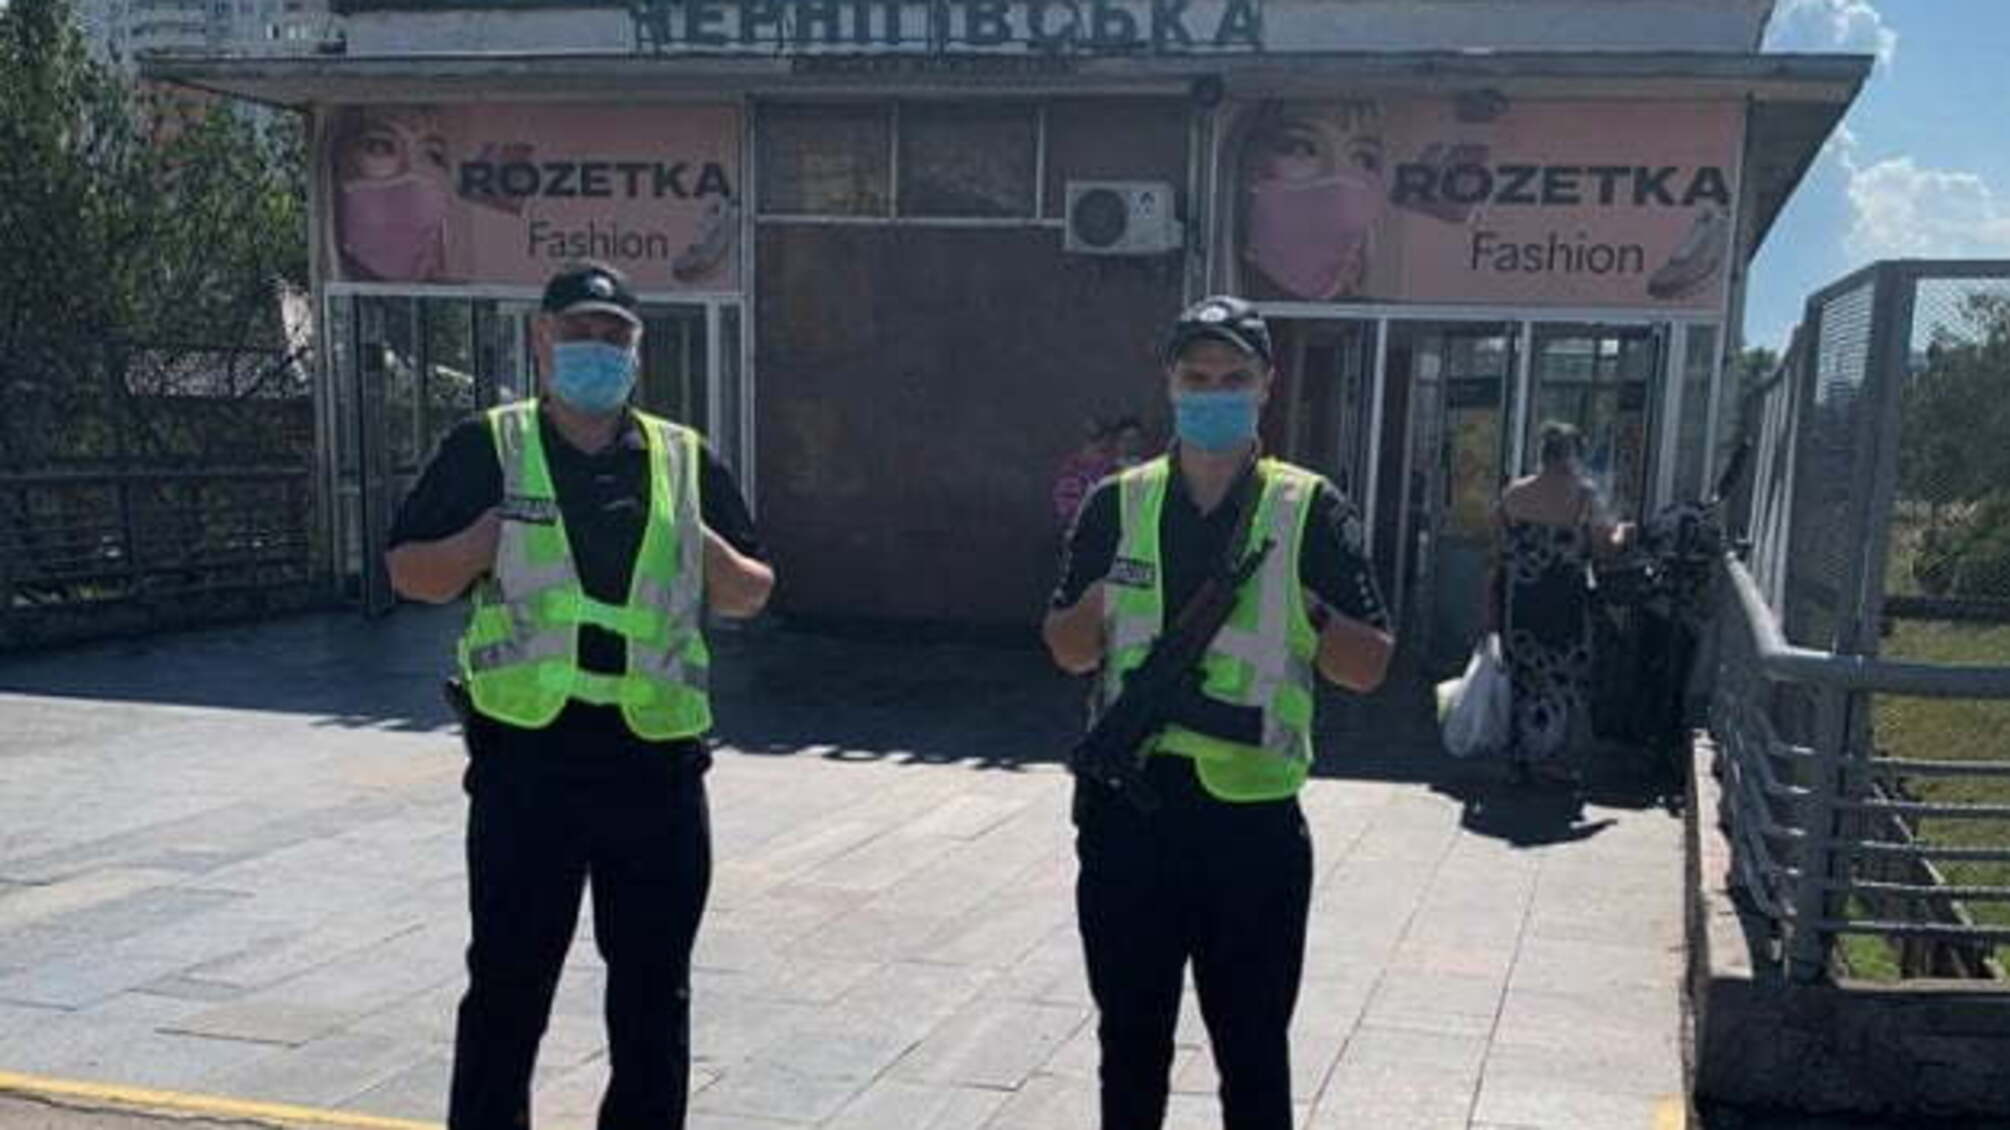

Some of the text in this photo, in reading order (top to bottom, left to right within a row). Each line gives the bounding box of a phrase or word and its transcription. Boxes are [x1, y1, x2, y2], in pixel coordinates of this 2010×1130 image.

[459, 161, 731, 198] ROZETKA
[1392, 163, 1732, 206] ROZETKA
[528, 220, 669, 259] Fashion
[1470, 230, 1645, 274] Fashion
